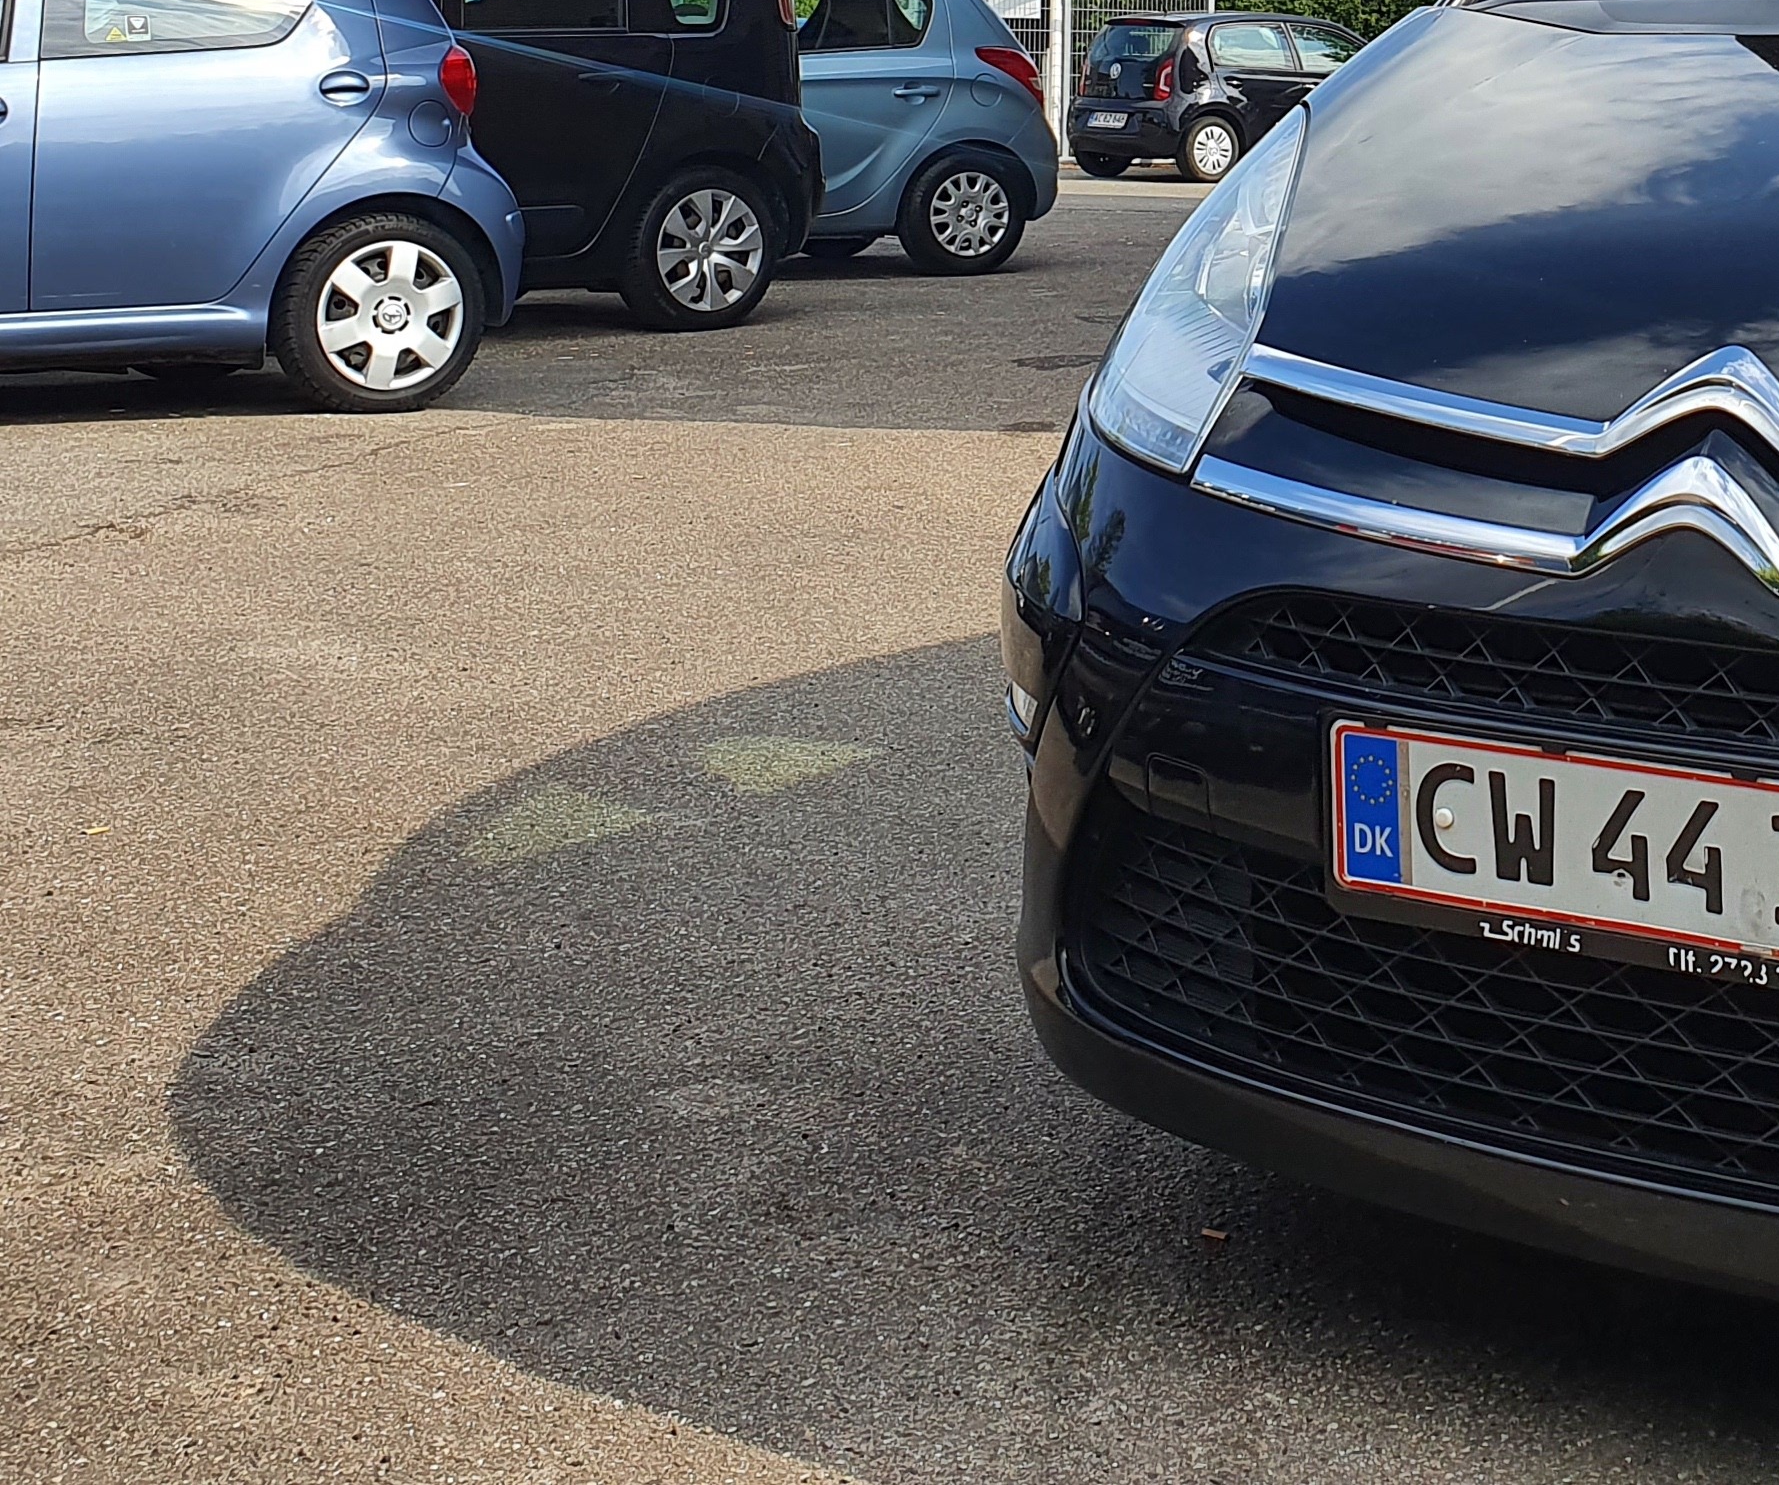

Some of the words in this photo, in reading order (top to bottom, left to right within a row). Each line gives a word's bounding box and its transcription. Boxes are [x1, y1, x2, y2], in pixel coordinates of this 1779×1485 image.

[1353, 822, 1394, 858] DK
[1416, 762, 1556, 887] CW
[1591, 789, 1724, 915] 44
